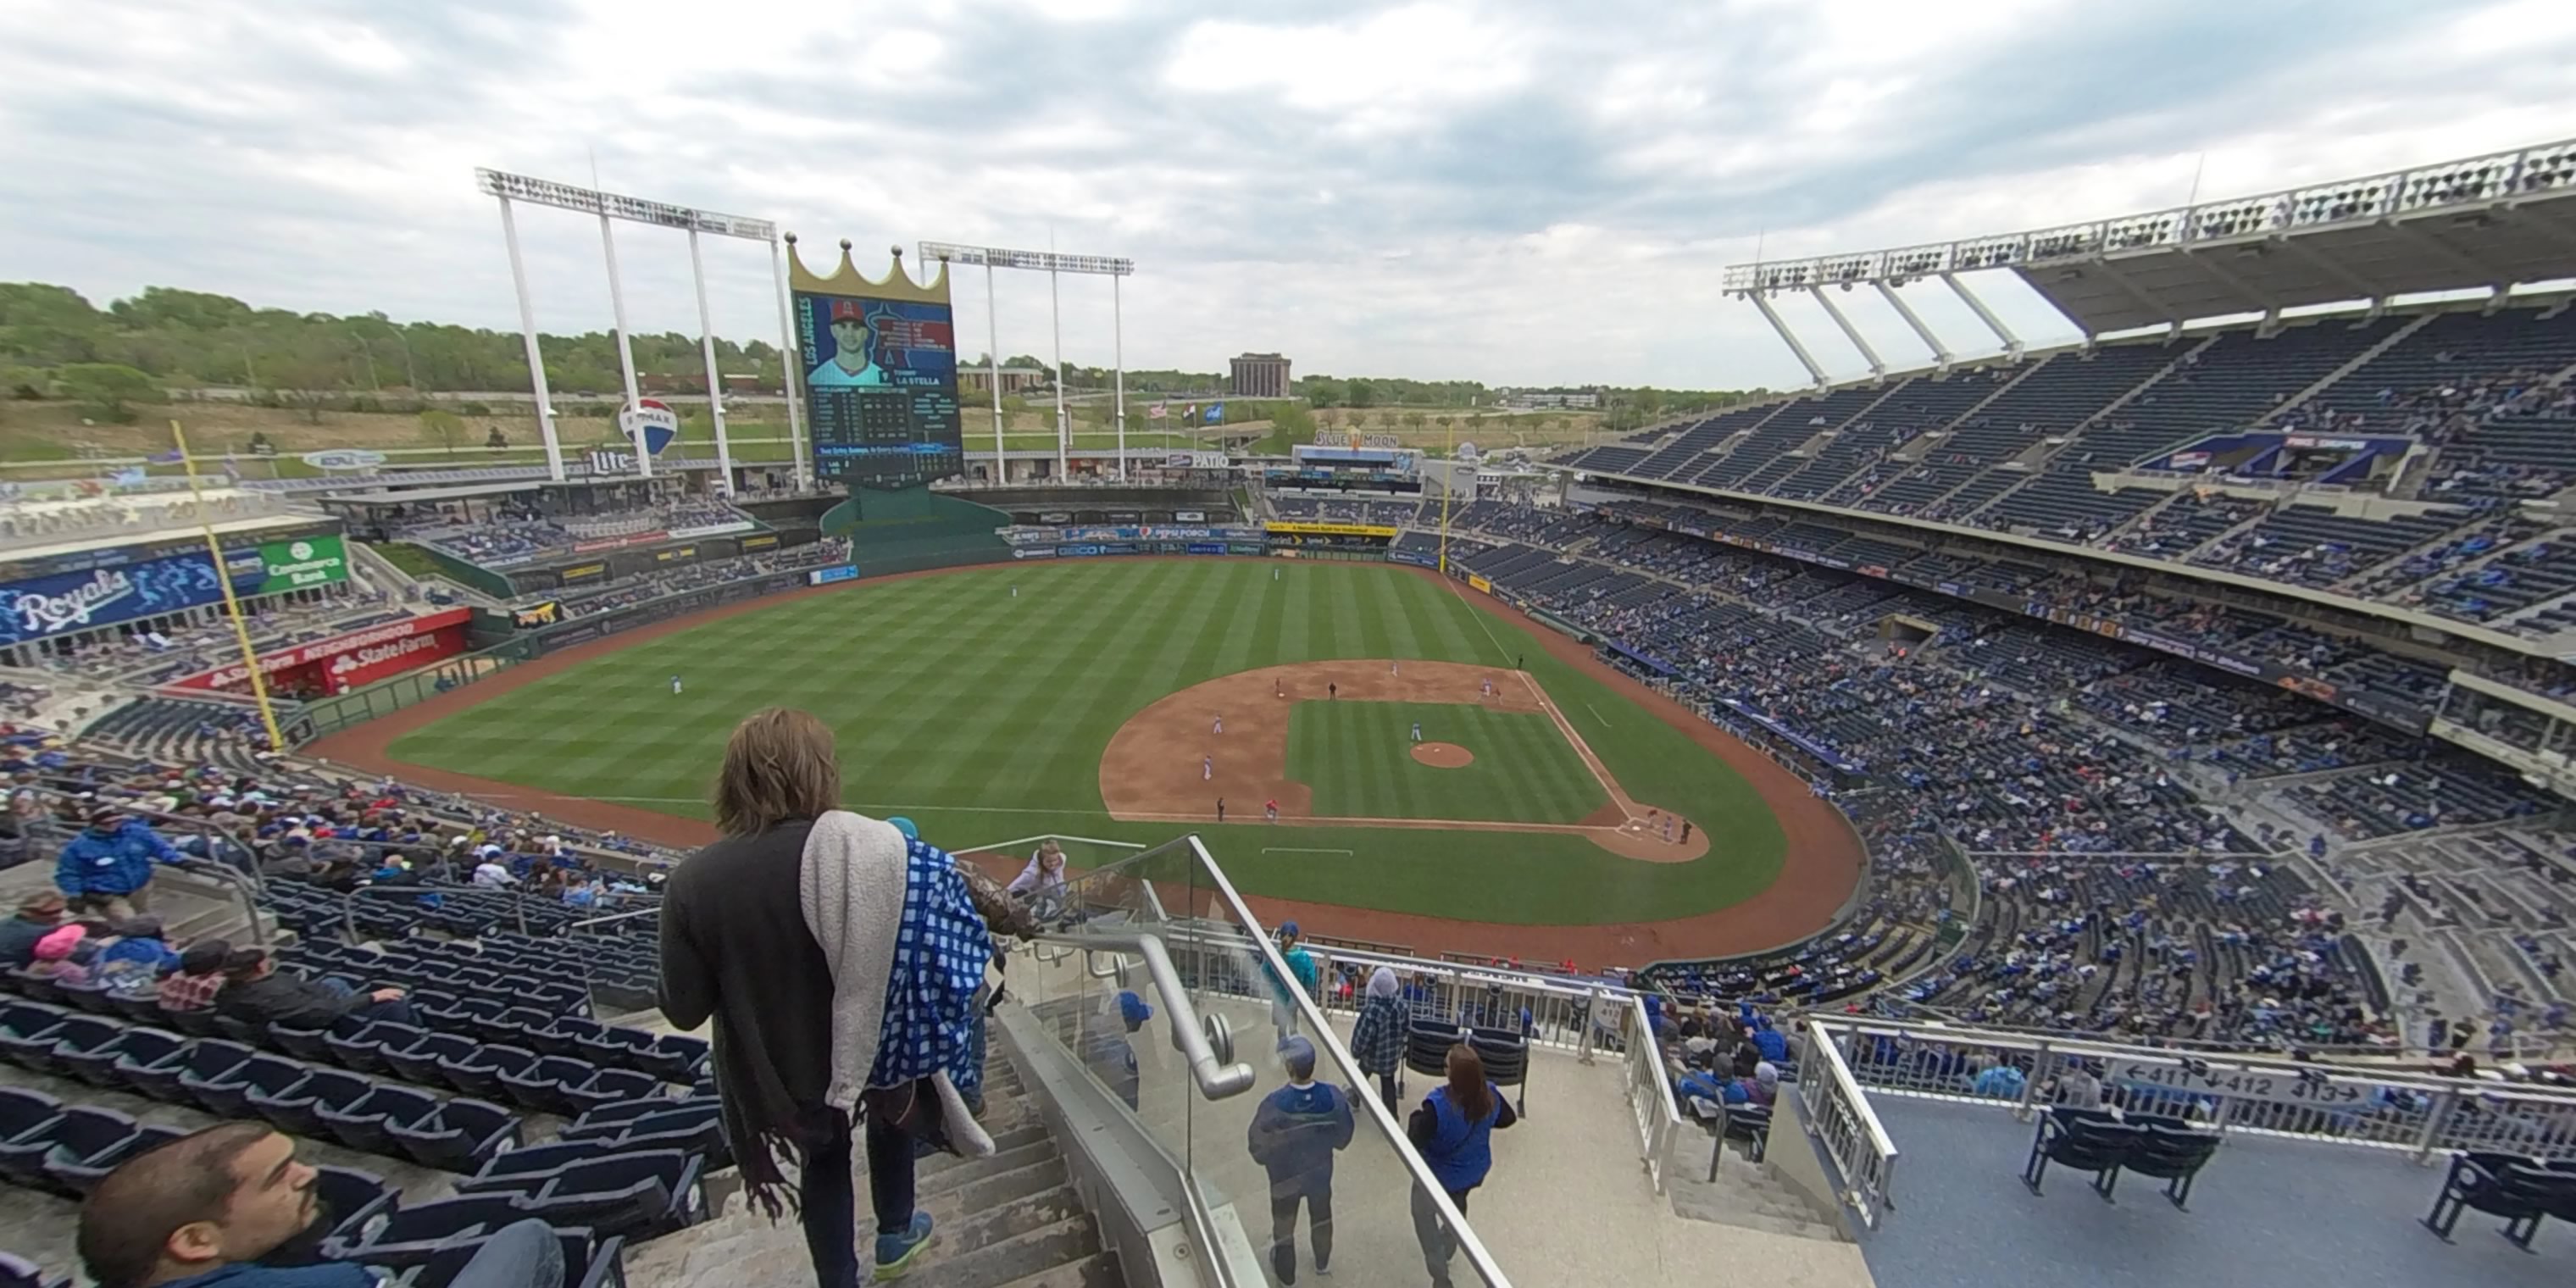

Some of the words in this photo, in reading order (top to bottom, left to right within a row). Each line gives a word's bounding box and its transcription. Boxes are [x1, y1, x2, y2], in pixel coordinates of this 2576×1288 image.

[798, 297, 816, 344] ANGELES
[908, 377, 941, 386] STELLA
[1315, 430, 1348, 447] BLUE
[1363, 434, 1398, 447] MOON
[591, 451, 630, 475] Lite
[1192, 455, 1229, 467] PATIO
[14, 569, 133, 632] Royals
[2148, 1068, 2190, 1086] 411
[2227, 1076, 2273, 1096] 412
[2290, 1081, 2339, 1102] 413
